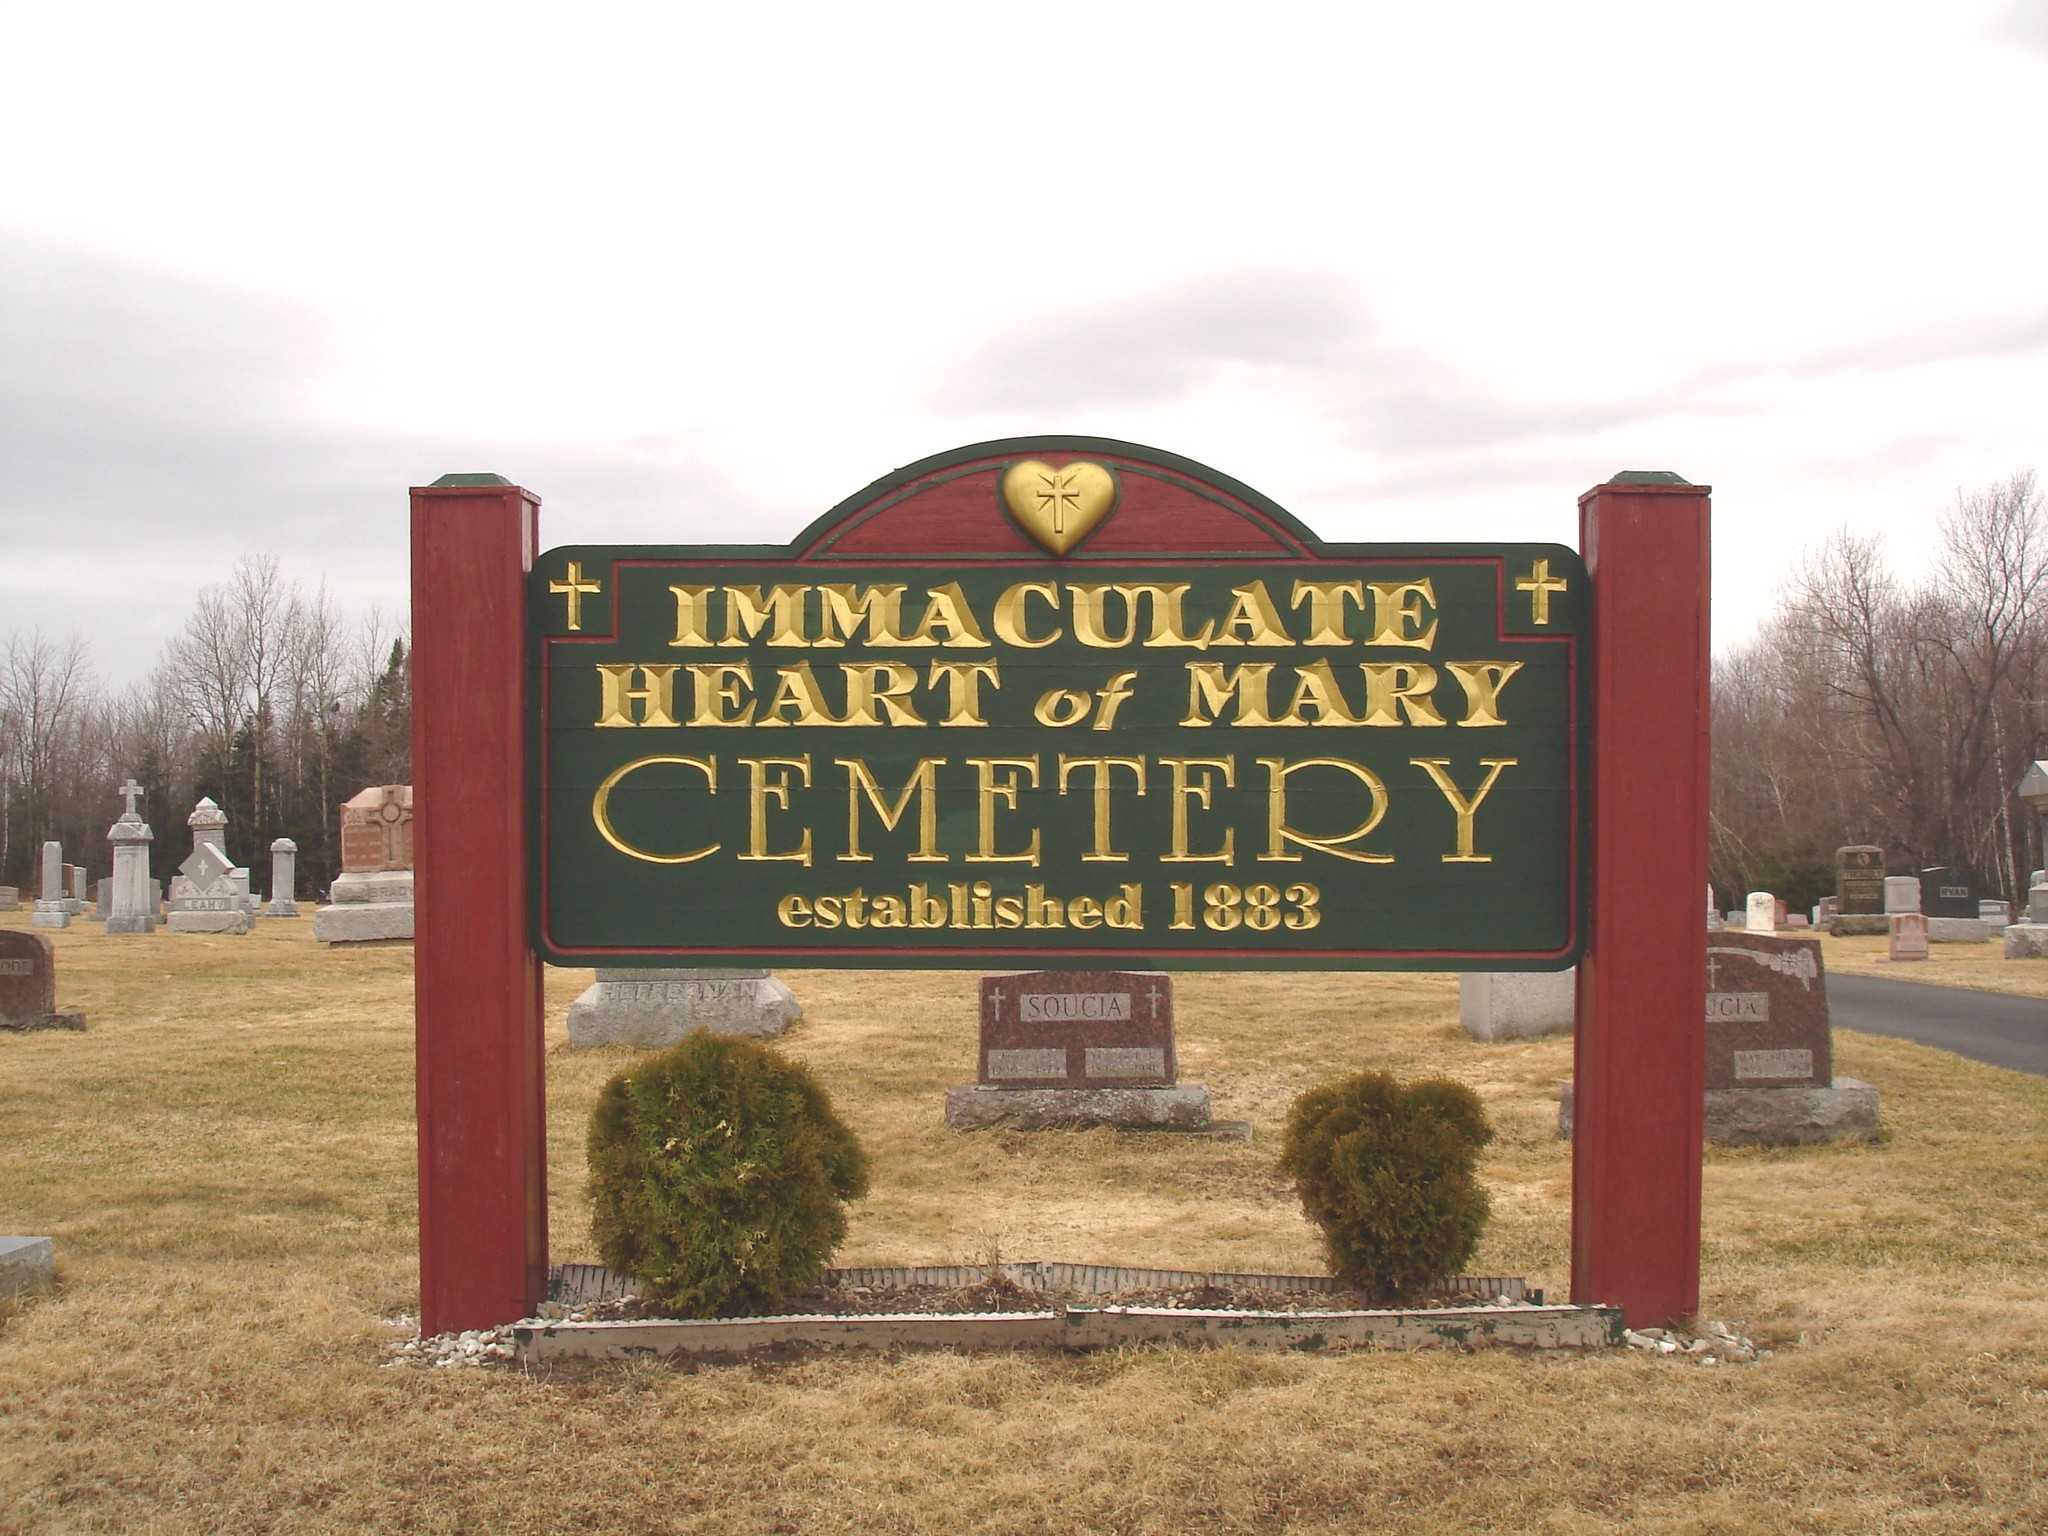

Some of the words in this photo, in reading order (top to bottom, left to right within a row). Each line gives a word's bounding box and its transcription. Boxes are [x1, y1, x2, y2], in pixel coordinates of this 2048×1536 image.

[668, 577, 1439, 651] IMMACULATE
[594, 658, 1001, 727] HEART
[1034, 671, 1139, 731] of
[1178, 657, 1525, 728] MARY
[592, 752, 1519, 868] CEMETERY
[777, 880, 1145, 931] established
[1168, 881, 1322, 932] 1883
[1941, 887, 1968, 898] RYAN
[600, 981, 758, 1002] HEFFERNAN
[1027, 995, 1123, 1018] SOUCIA
